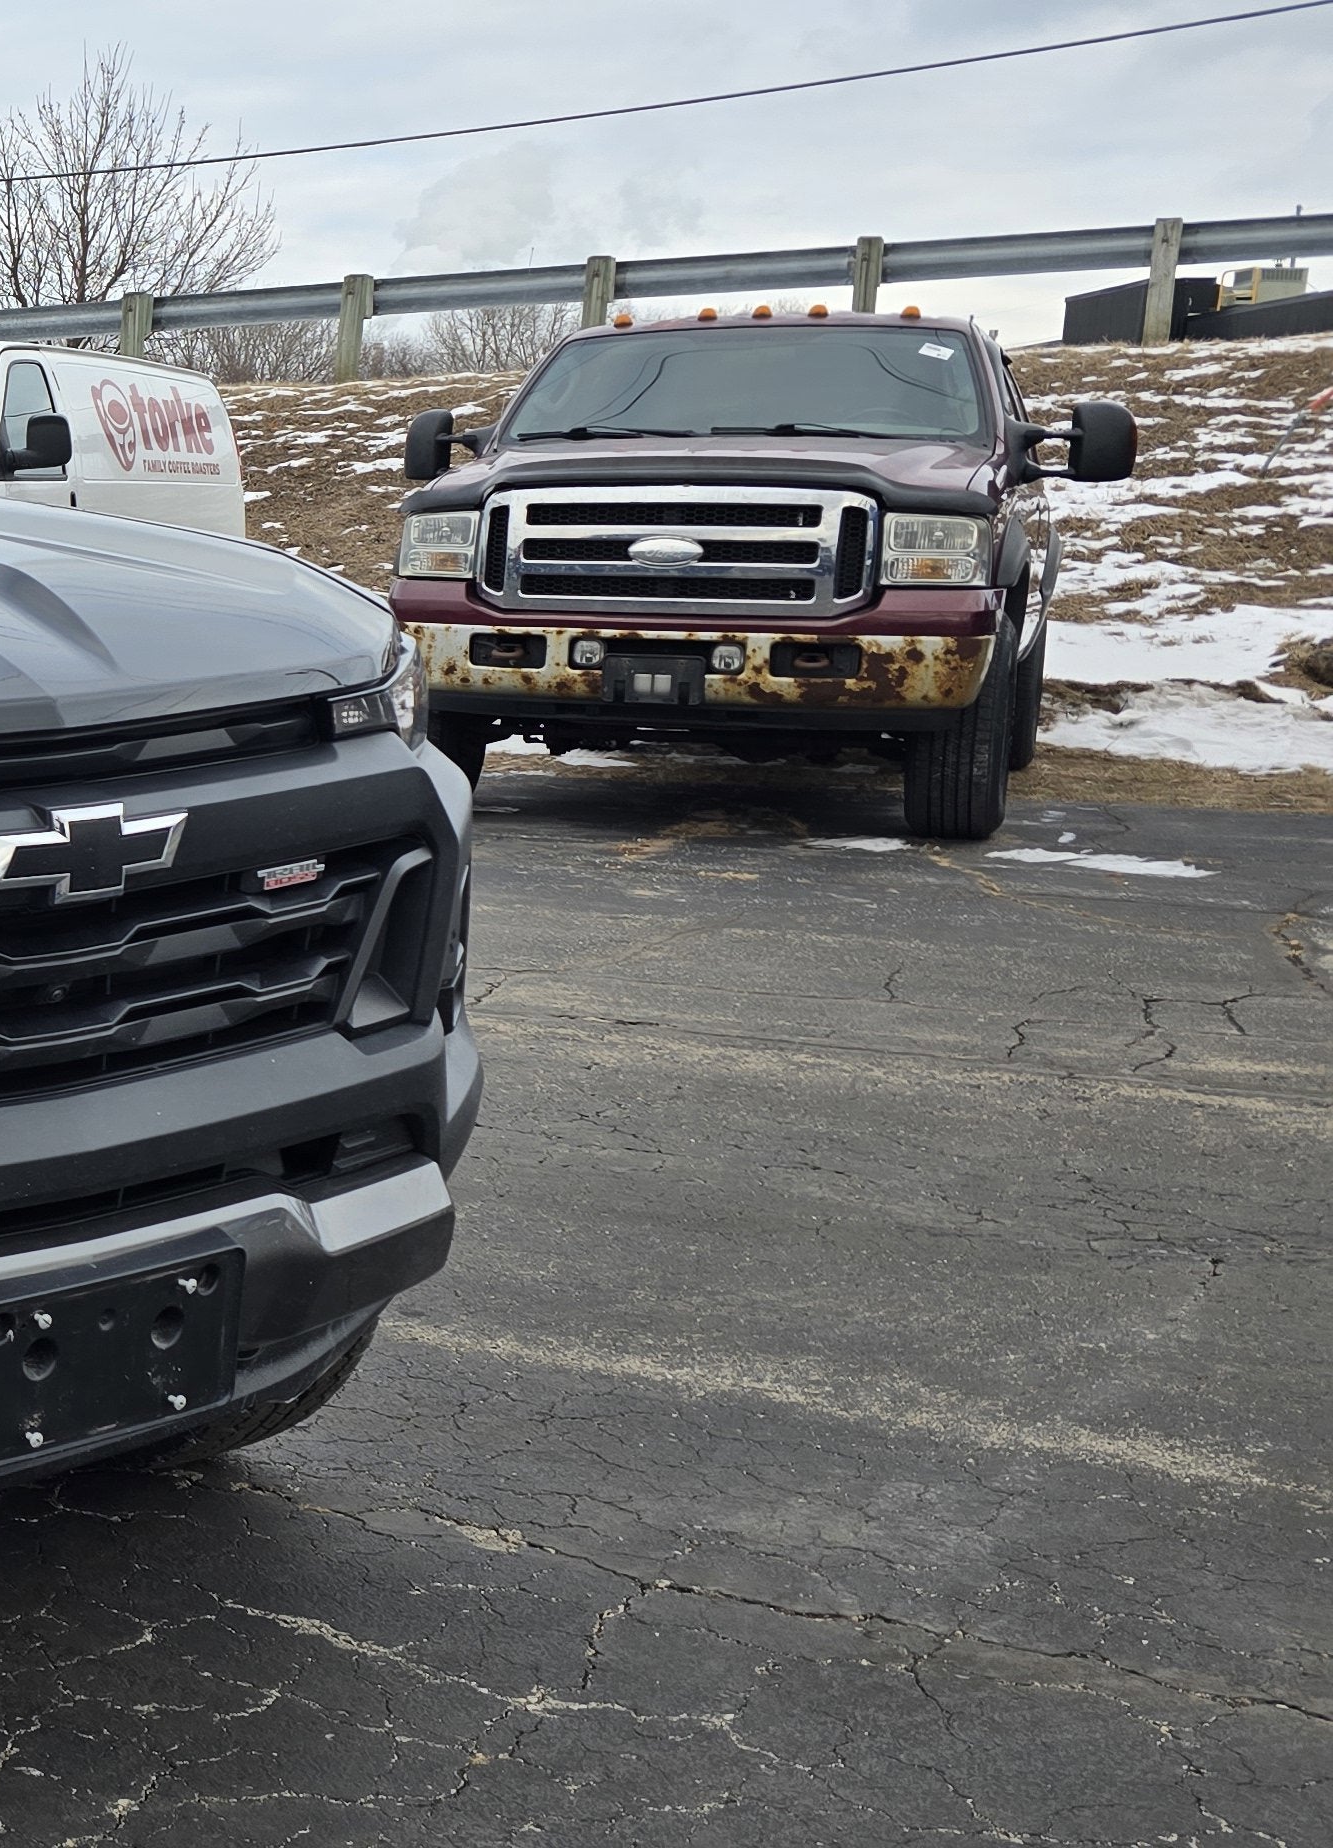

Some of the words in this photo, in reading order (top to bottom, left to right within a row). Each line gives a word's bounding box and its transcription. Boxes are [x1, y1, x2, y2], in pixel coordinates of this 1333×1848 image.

[129, 383, 214, 455] torke
[143, 460, 166, 473] FAMILY
[168, 460, 190, 474] COFFEE
[191, 462, 220, 476] ROASTERS
[257, 859, 325, 880] TRAIL
